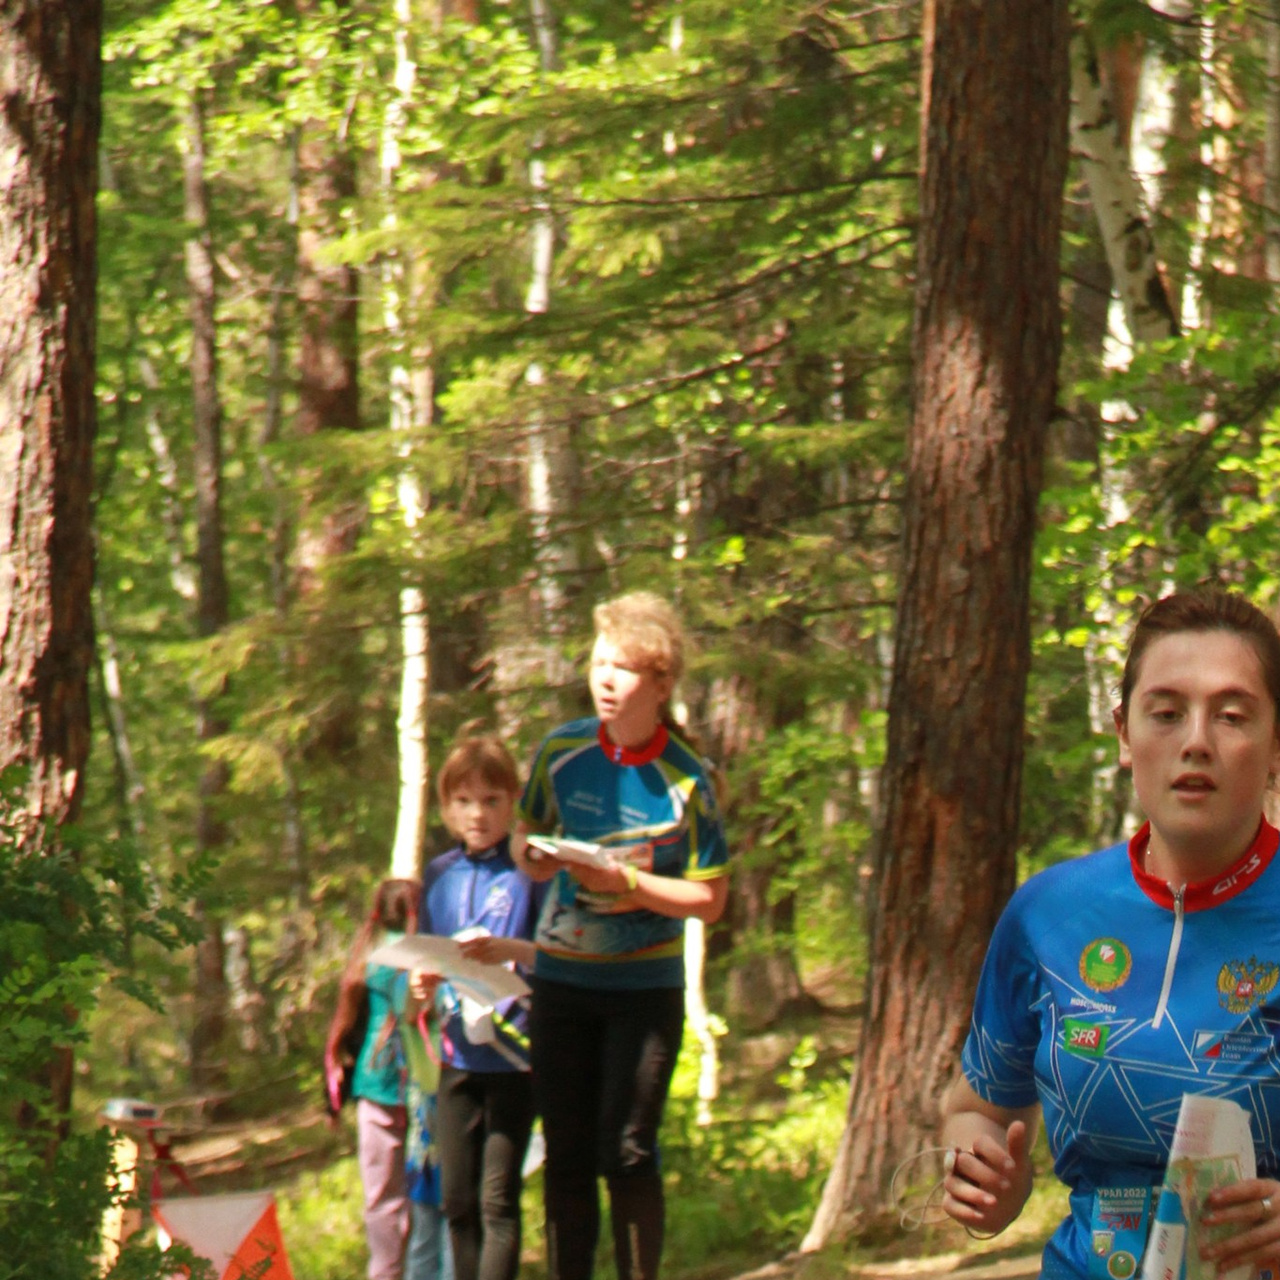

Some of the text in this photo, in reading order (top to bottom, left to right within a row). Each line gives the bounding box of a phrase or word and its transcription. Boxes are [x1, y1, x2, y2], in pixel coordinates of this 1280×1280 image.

[1070, 1026, 1097, 1045] SFR
[1097, 1188, 1147, 1198] УРАЛ 2022
